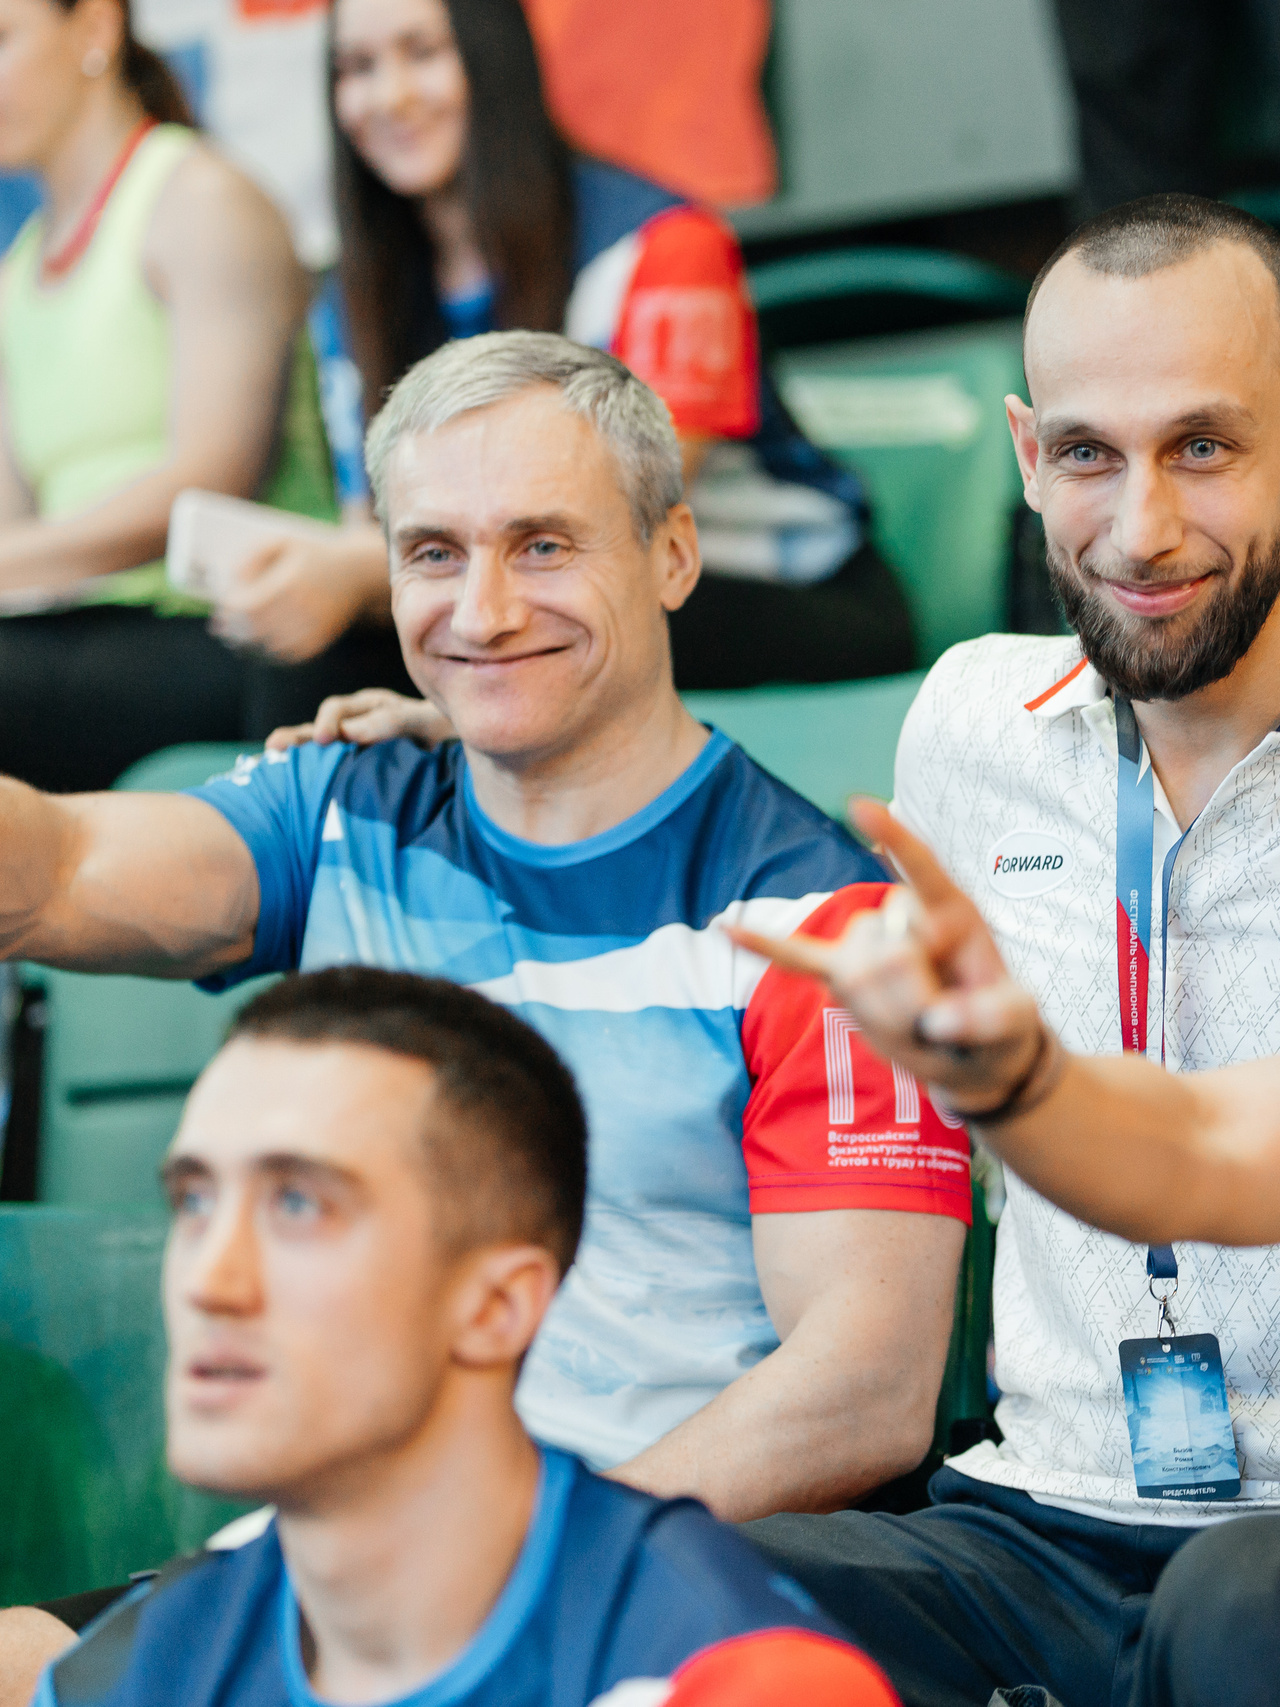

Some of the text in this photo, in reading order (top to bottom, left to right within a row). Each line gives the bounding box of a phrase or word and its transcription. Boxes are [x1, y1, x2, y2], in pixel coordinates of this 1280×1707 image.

[994, 854, 1064, 875] FORWARD
[1129, 889, 1140, 1055] ФЕСТИВАЛЬ ЧЕМПИОНОВ «ИГР
[828, 1129, 921, 1144] Всероссийский
[872, 1157, 880, 1168] к
[882, 1156, 916, 1171] труду
[1162, 1486, 1217, 1497] ПРЕДСТАВИТЕЛЬ
